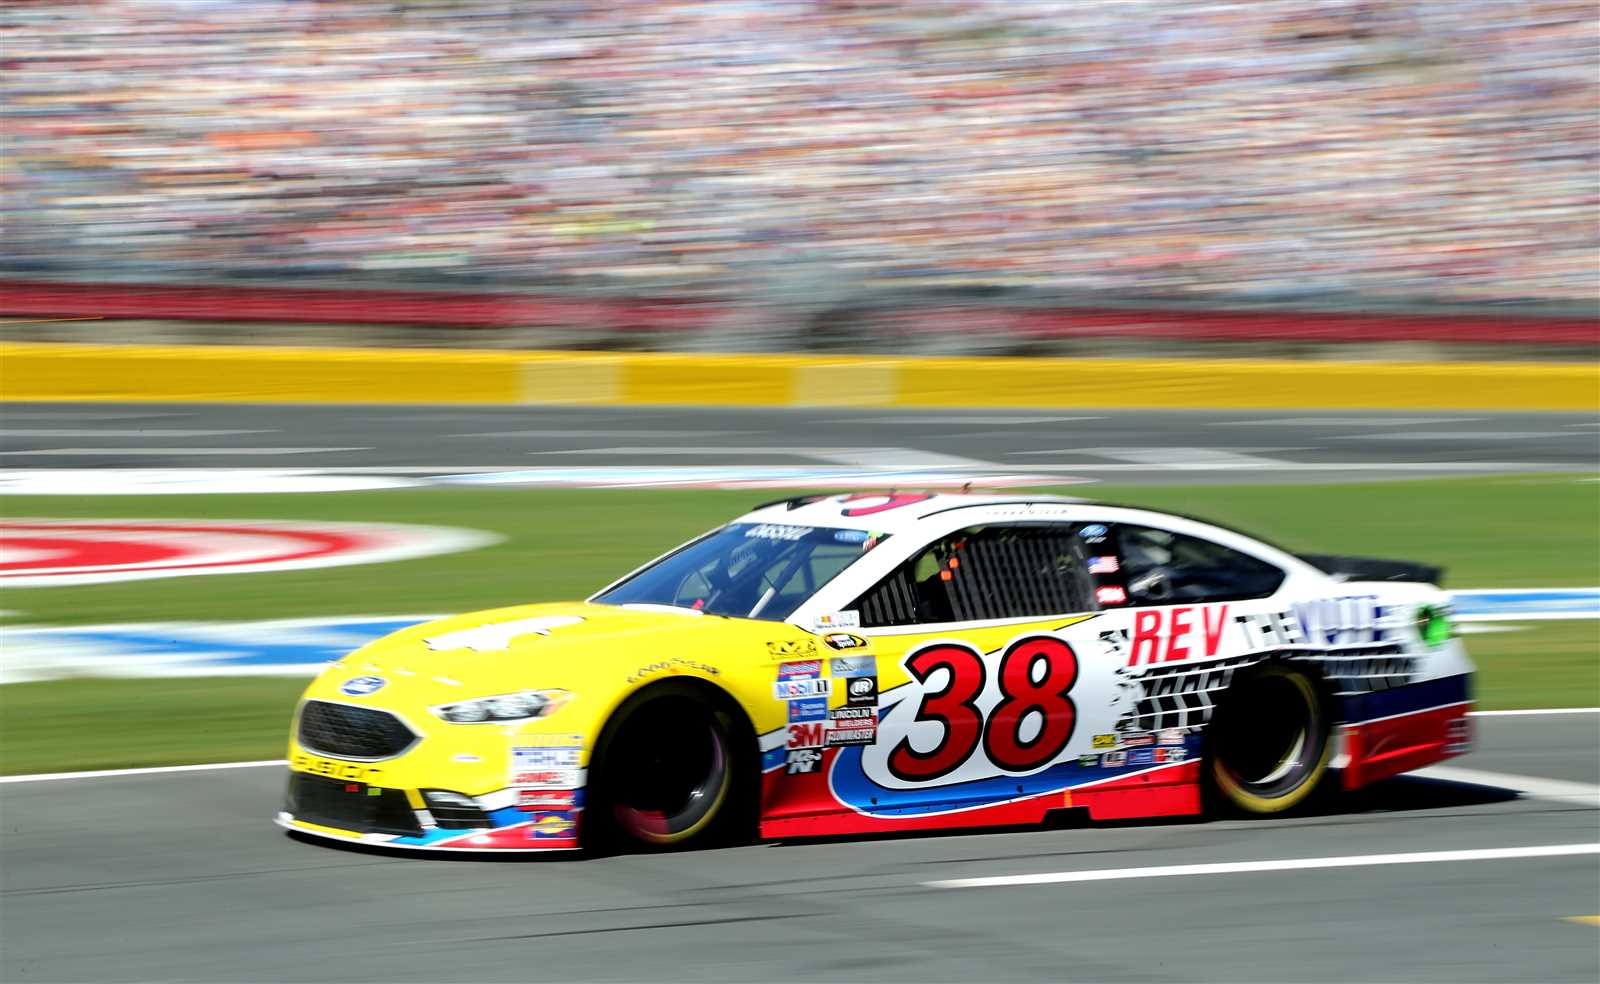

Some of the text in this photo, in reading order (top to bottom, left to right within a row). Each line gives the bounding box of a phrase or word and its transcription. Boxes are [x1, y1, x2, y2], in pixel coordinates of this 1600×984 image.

[1127, 604, 1229, 668] REV
[830, 707, 871, 720] LINCOLN
[887, 635, 1079, 782] 38
[787, 722, 824, 748] 3M
